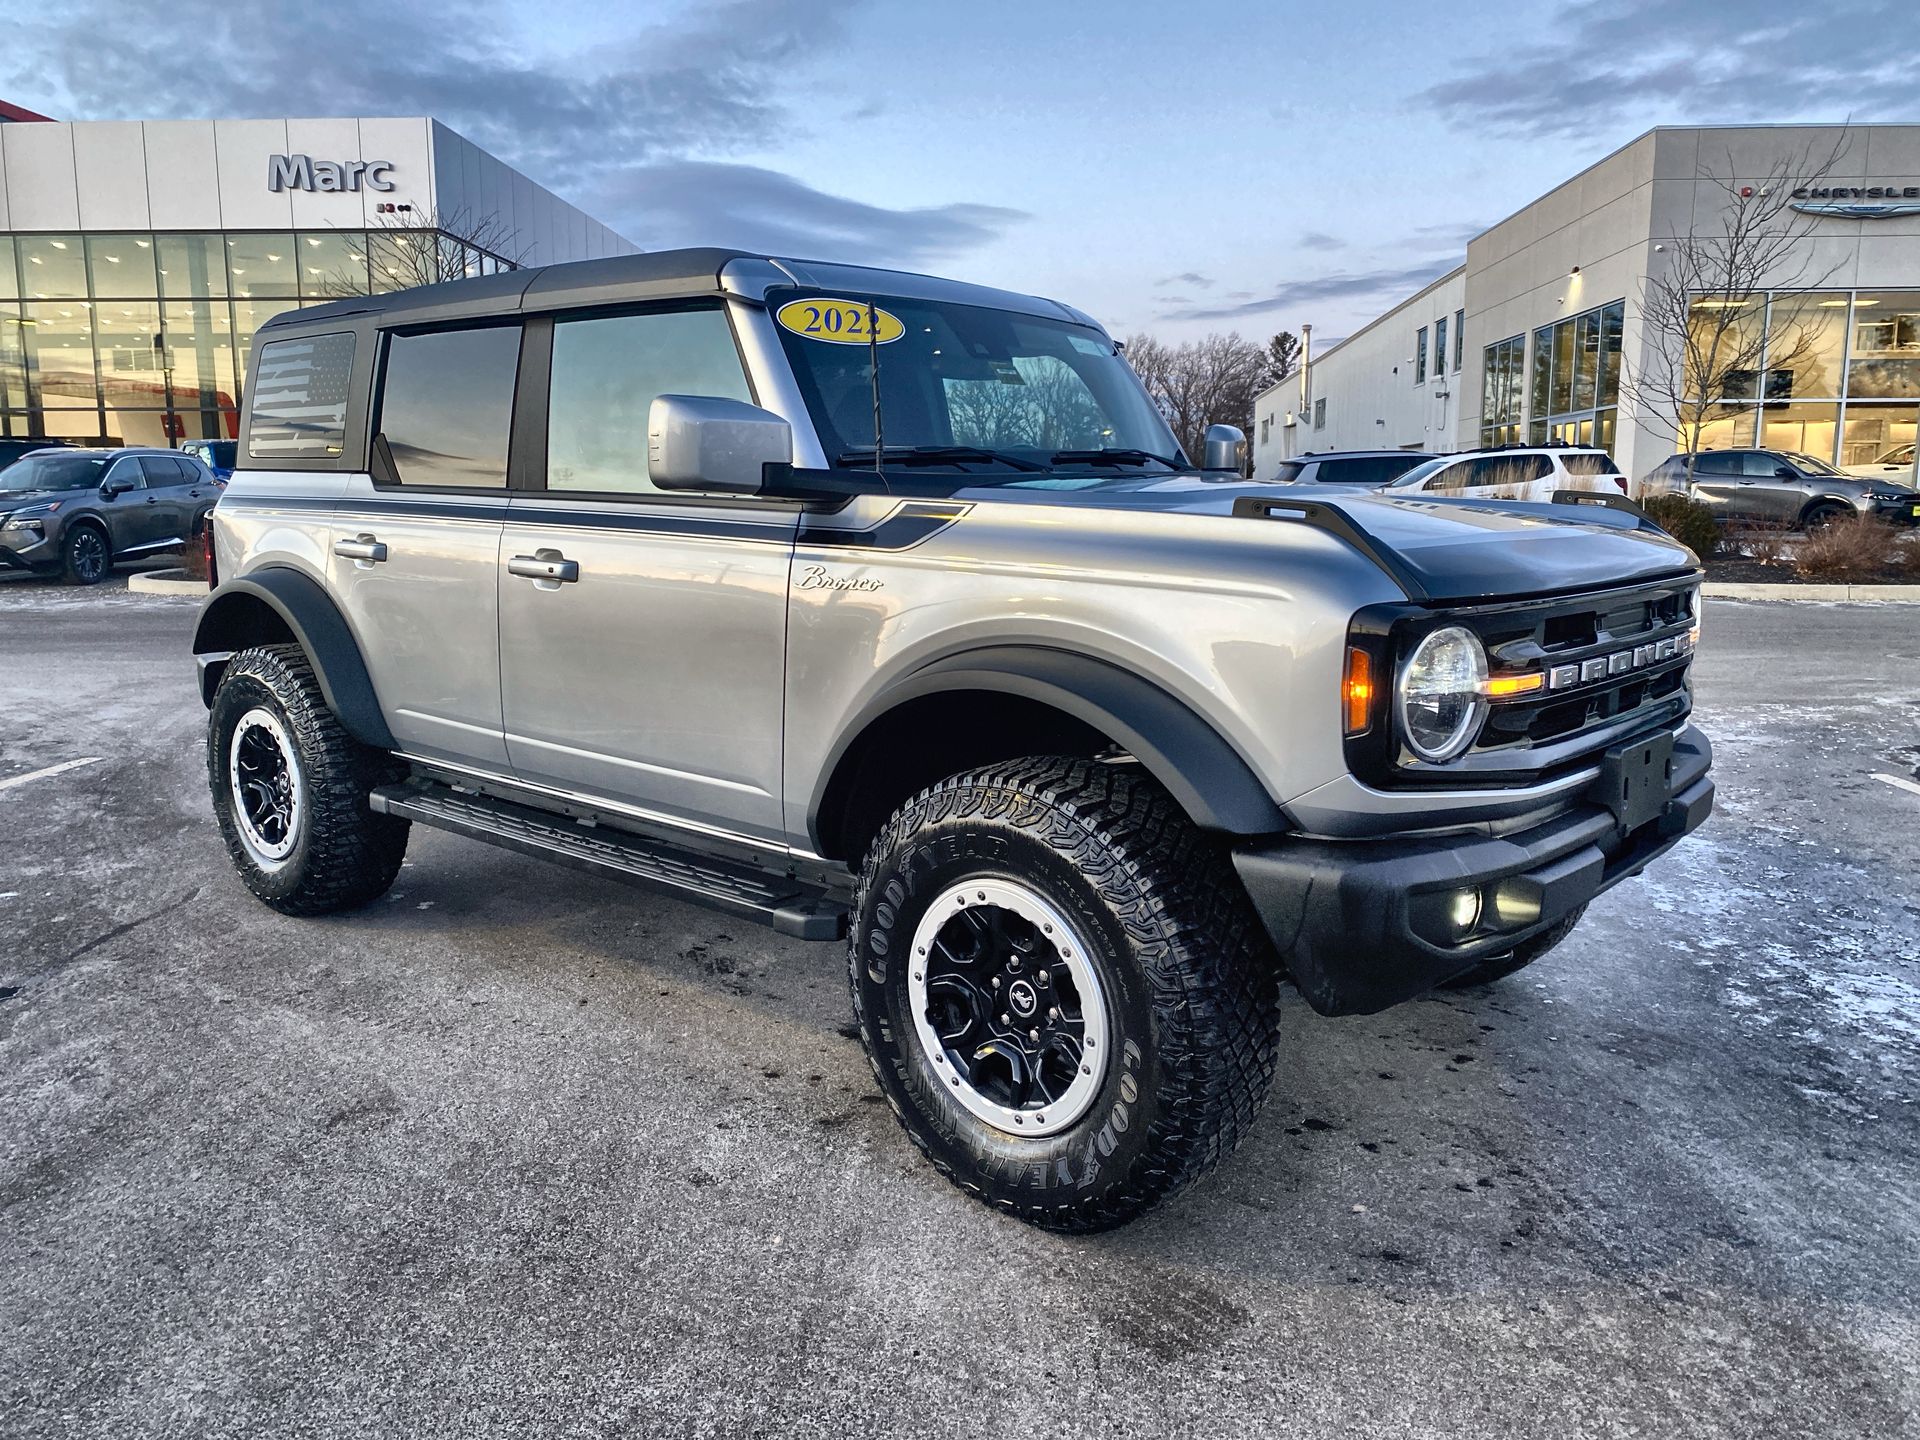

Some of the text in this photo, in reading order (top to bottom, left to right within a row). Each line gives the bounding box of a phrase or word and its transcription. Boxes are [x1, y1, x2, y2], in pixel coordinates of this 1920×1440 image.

[268, 154, 396, 193] Marc
[803, 307, 881, 335] 2022
[794, 564, 884, 592] Bronco
[1550, 632, 1692, 689] BRONCO
